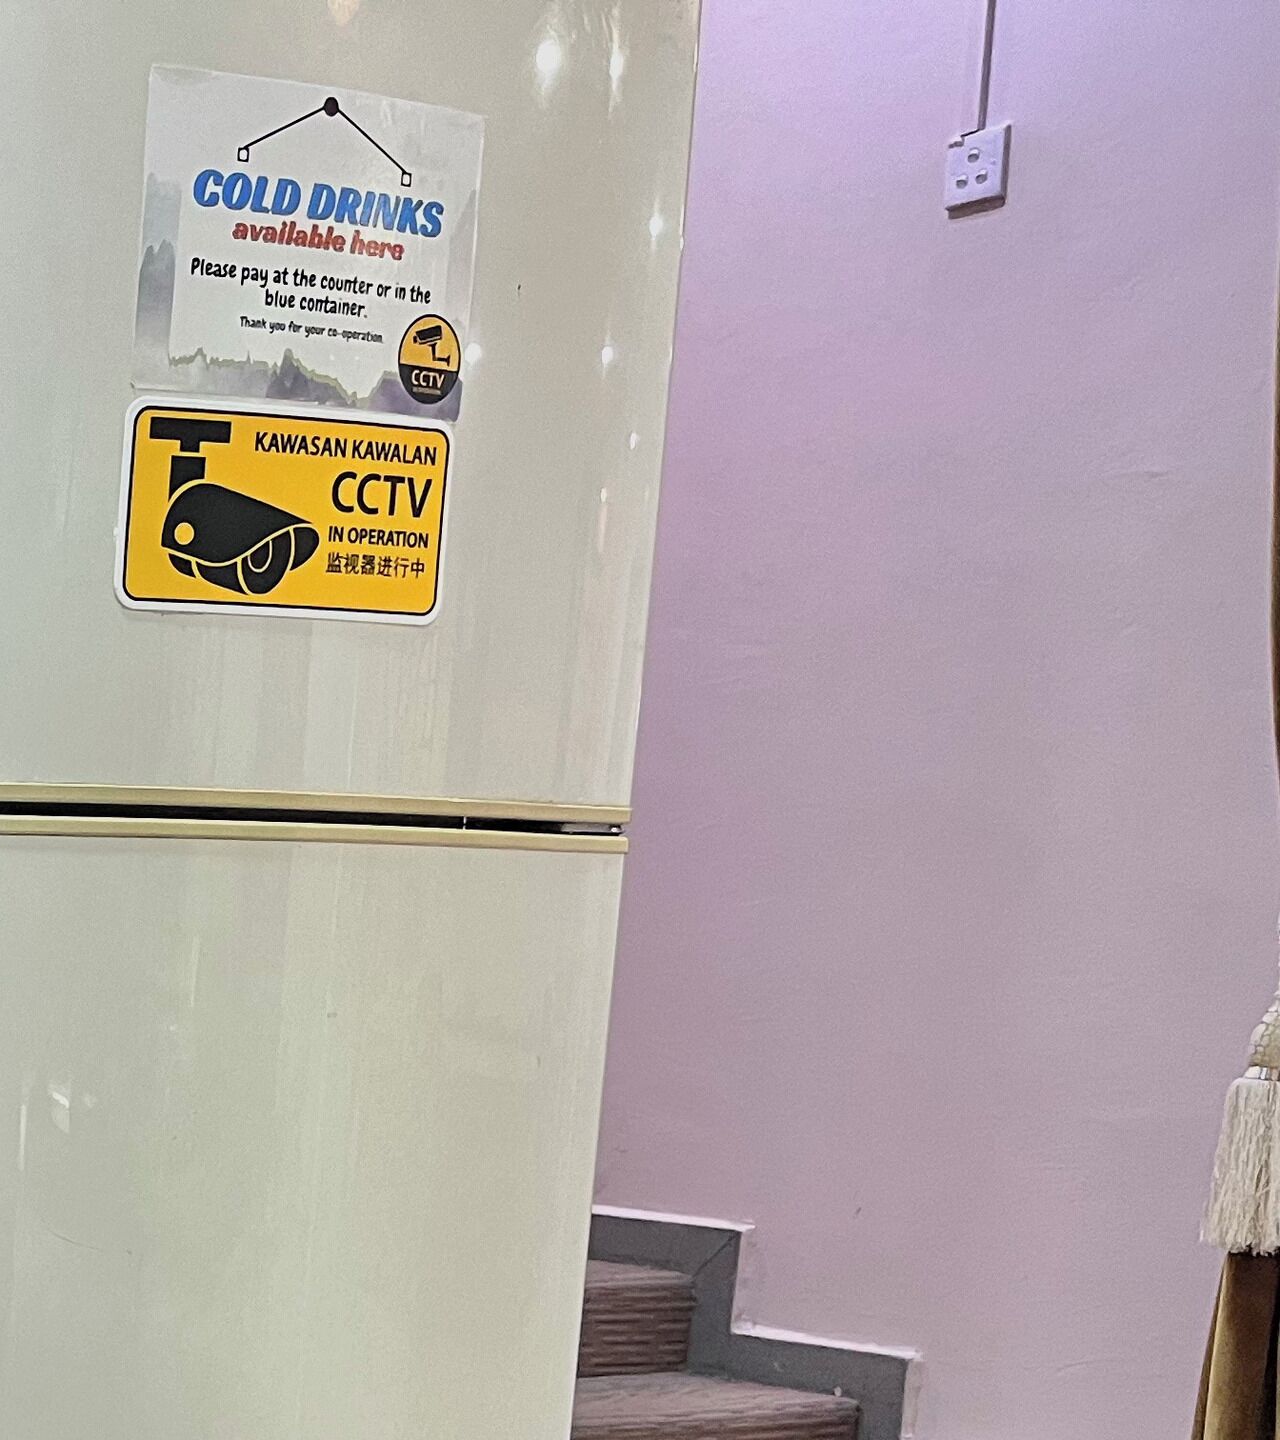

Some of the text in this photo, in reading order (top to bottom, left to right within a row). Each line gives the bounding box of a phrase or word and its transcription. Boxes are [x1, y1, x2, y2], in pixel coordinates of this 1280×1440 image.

[193, 168, 445, 238] COLD DRINKS
[232, 220, 405, 261] available here
[190, 257, 431, 304] Please pay at the counter or in the
[265, 289, 368, 318] blue container.
[240, 316, 266, 329] Thank
[269, 322, 286, 334] you
[289, 321, 302, 333] for
[305, 326, 325, 338] your
[412, 370, 445, 388] CCTV
[254, 431, 437, 466] KAWASAN KAWALAN
[332, 472, 432, 518] CCTV
[328, 526, 429, 549] IN OPERATION
[326, 552, 425, 579] 监视器进行中
